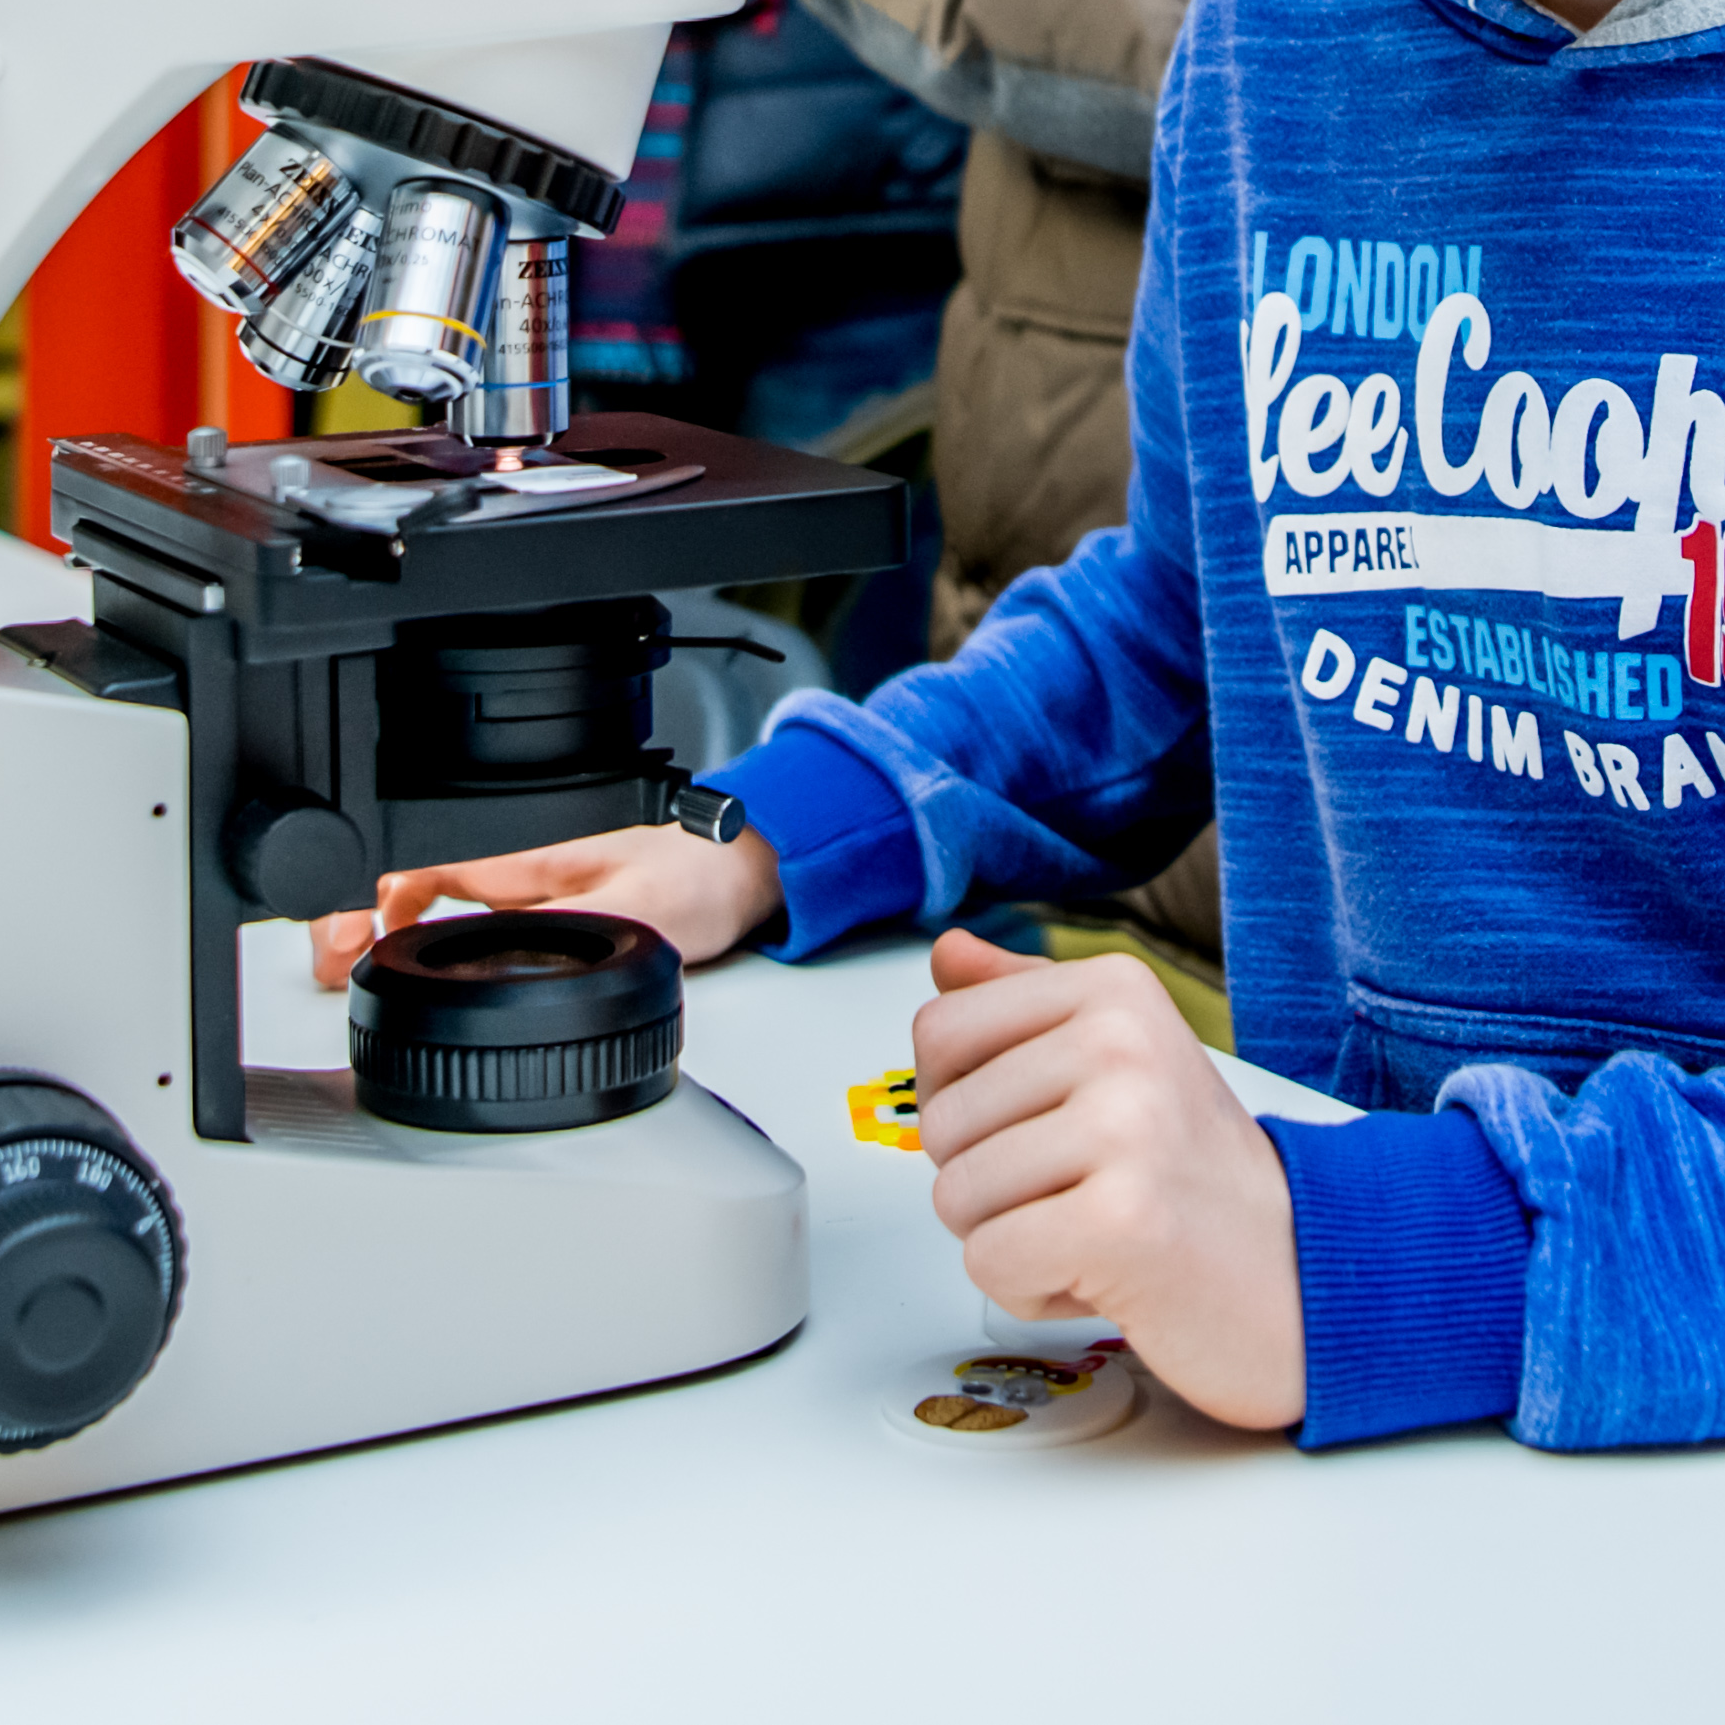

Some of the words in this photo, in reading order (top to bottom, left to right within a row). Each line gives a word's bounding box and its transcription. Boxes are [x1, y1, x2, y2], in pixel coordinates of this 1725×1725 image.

[1253, 231, 1483, 343] LONDON
[1286, 525, 1419, 574] APPARE
[1301, 629, 1544, 781] DENIM
[1404, 603, 1685, 722] ESTABLISHED
